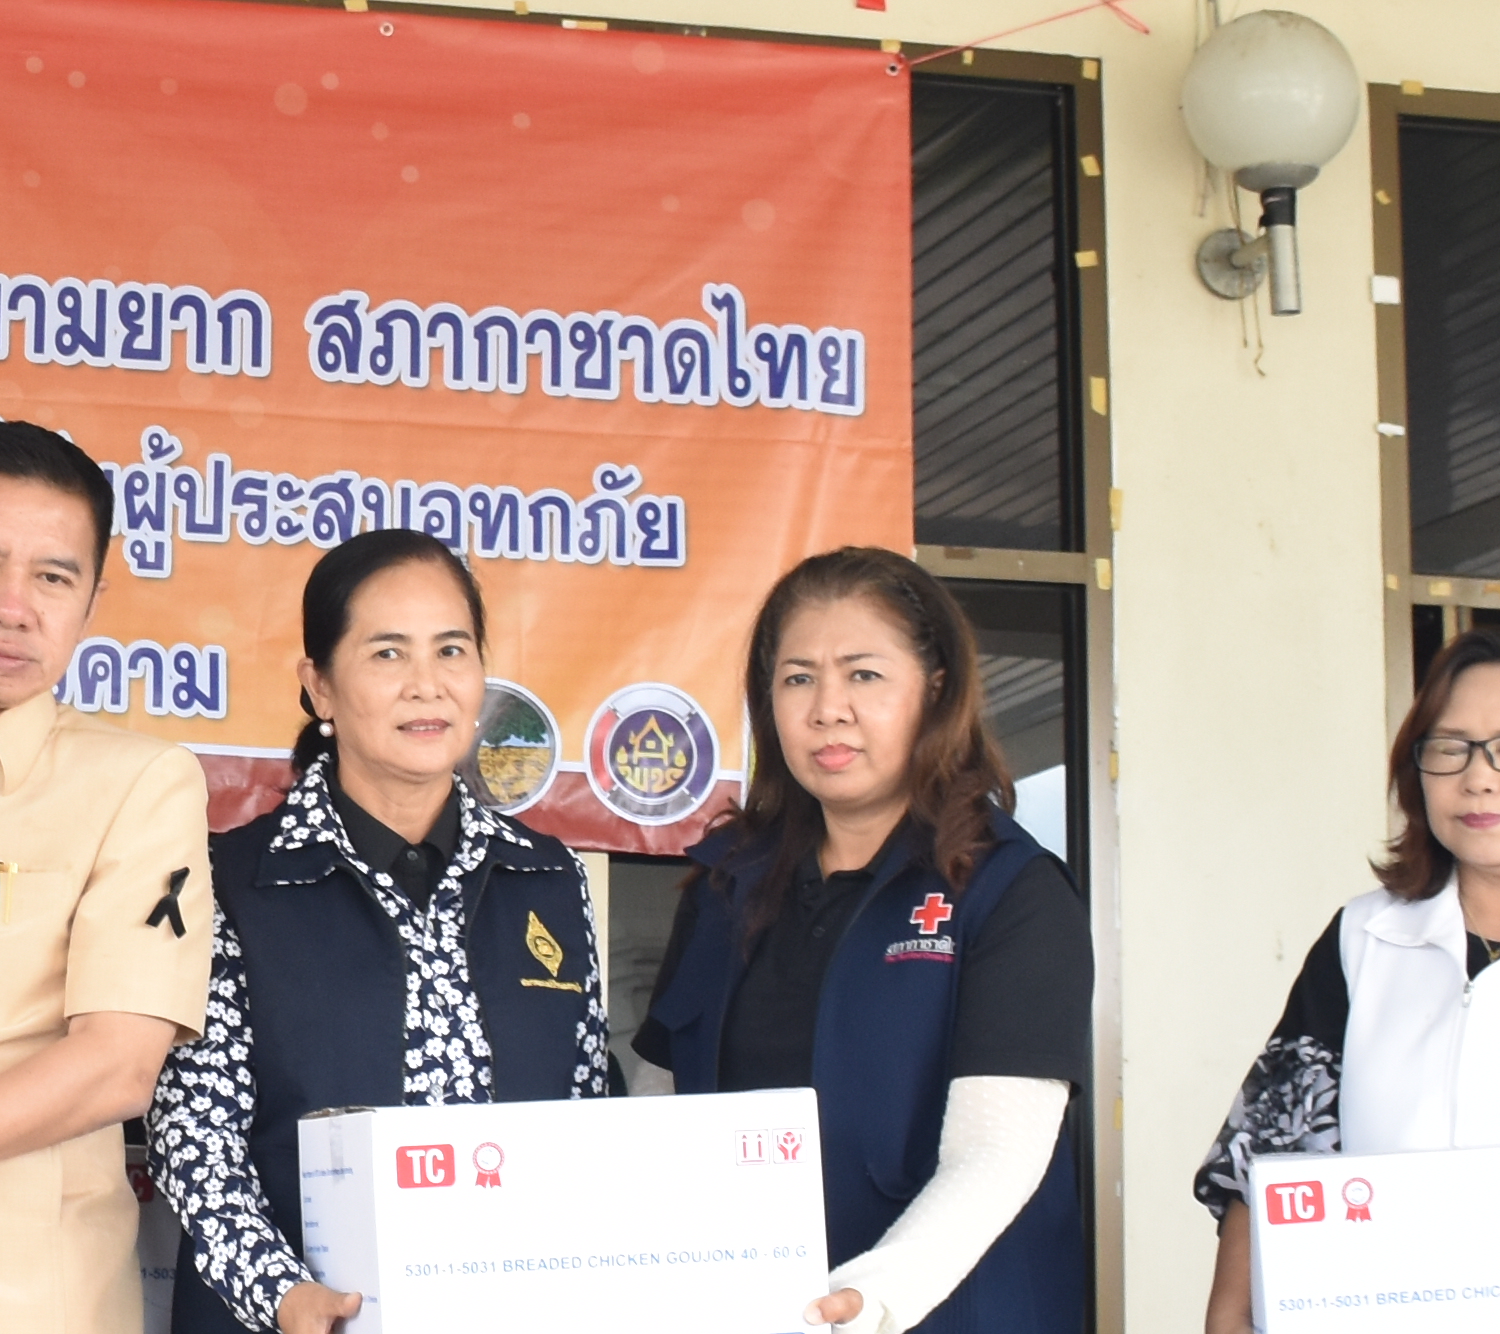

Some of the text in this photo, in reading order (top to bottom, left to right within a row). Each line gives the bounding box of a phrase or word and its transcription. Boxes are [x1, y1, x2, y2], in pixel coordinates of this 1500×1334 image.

[311, 291, 860, 408] สภากาชาดไทย
[404, 1146, 446, 1185] TC
[1274, 1183, 1316, 1222] TC
[405, 1261, 496, 1277] 5301-1-5031
[502, 1256, 582, 1273] BREADED
[587, 1252, 661, 1269] CHICKEN
[666, 1249, 735, 1265] GOUJON
[740, 1247, 758, 1260] 40
[773, 1246, 790, 1259] 60
[1278, 1294, 1369, 1312] 5301-1-5031
[1375, 1288, 1456, 1306] BREADED
